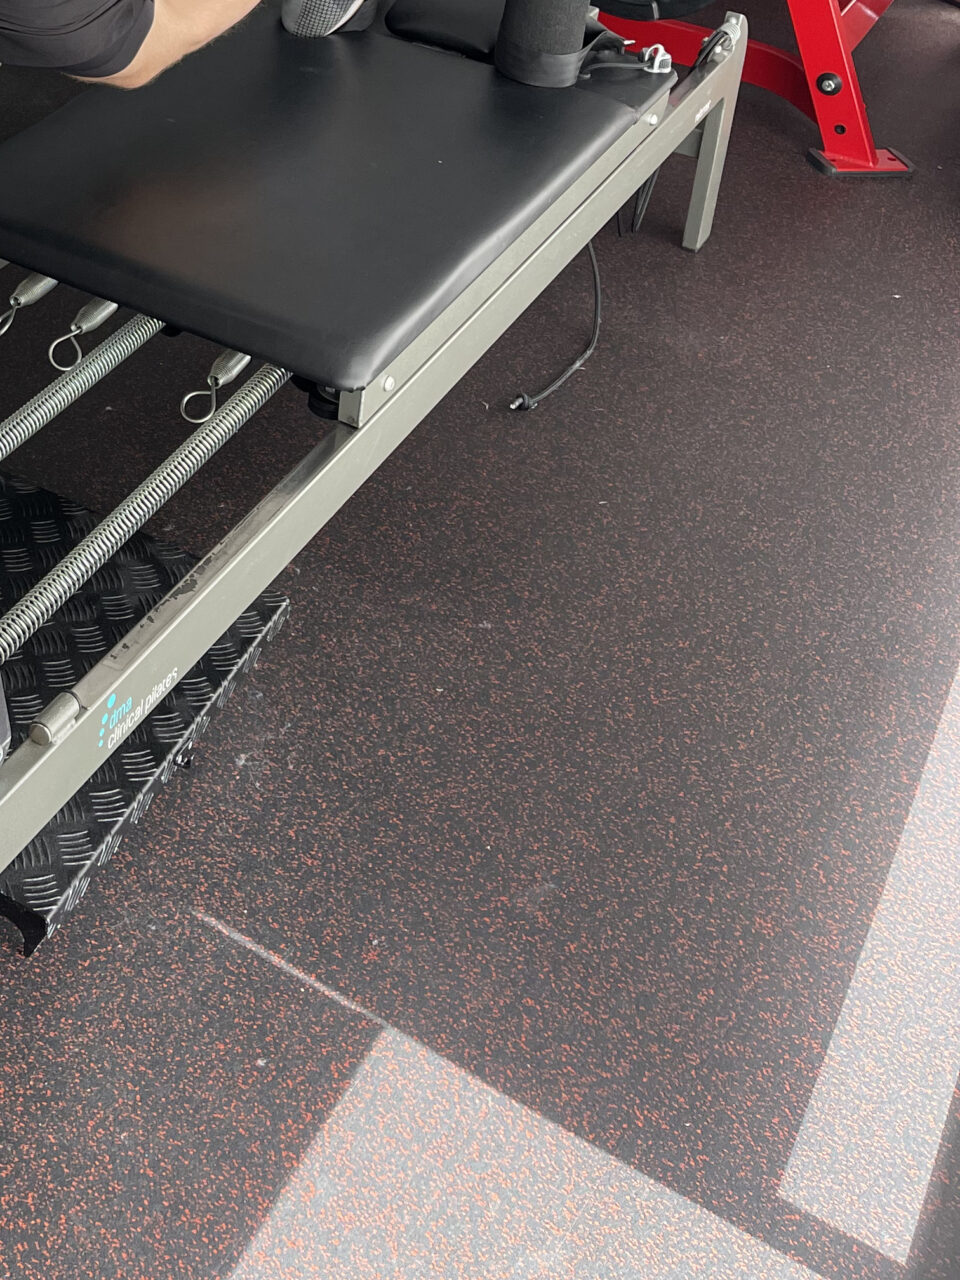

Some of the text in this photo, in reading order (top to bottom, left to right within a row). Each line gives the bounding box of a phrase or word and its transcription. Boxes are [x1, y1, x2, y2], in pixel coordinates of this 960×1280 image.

[107, 667, 178, 750] clinical pilates
[109, 696, 133, 730] dma
